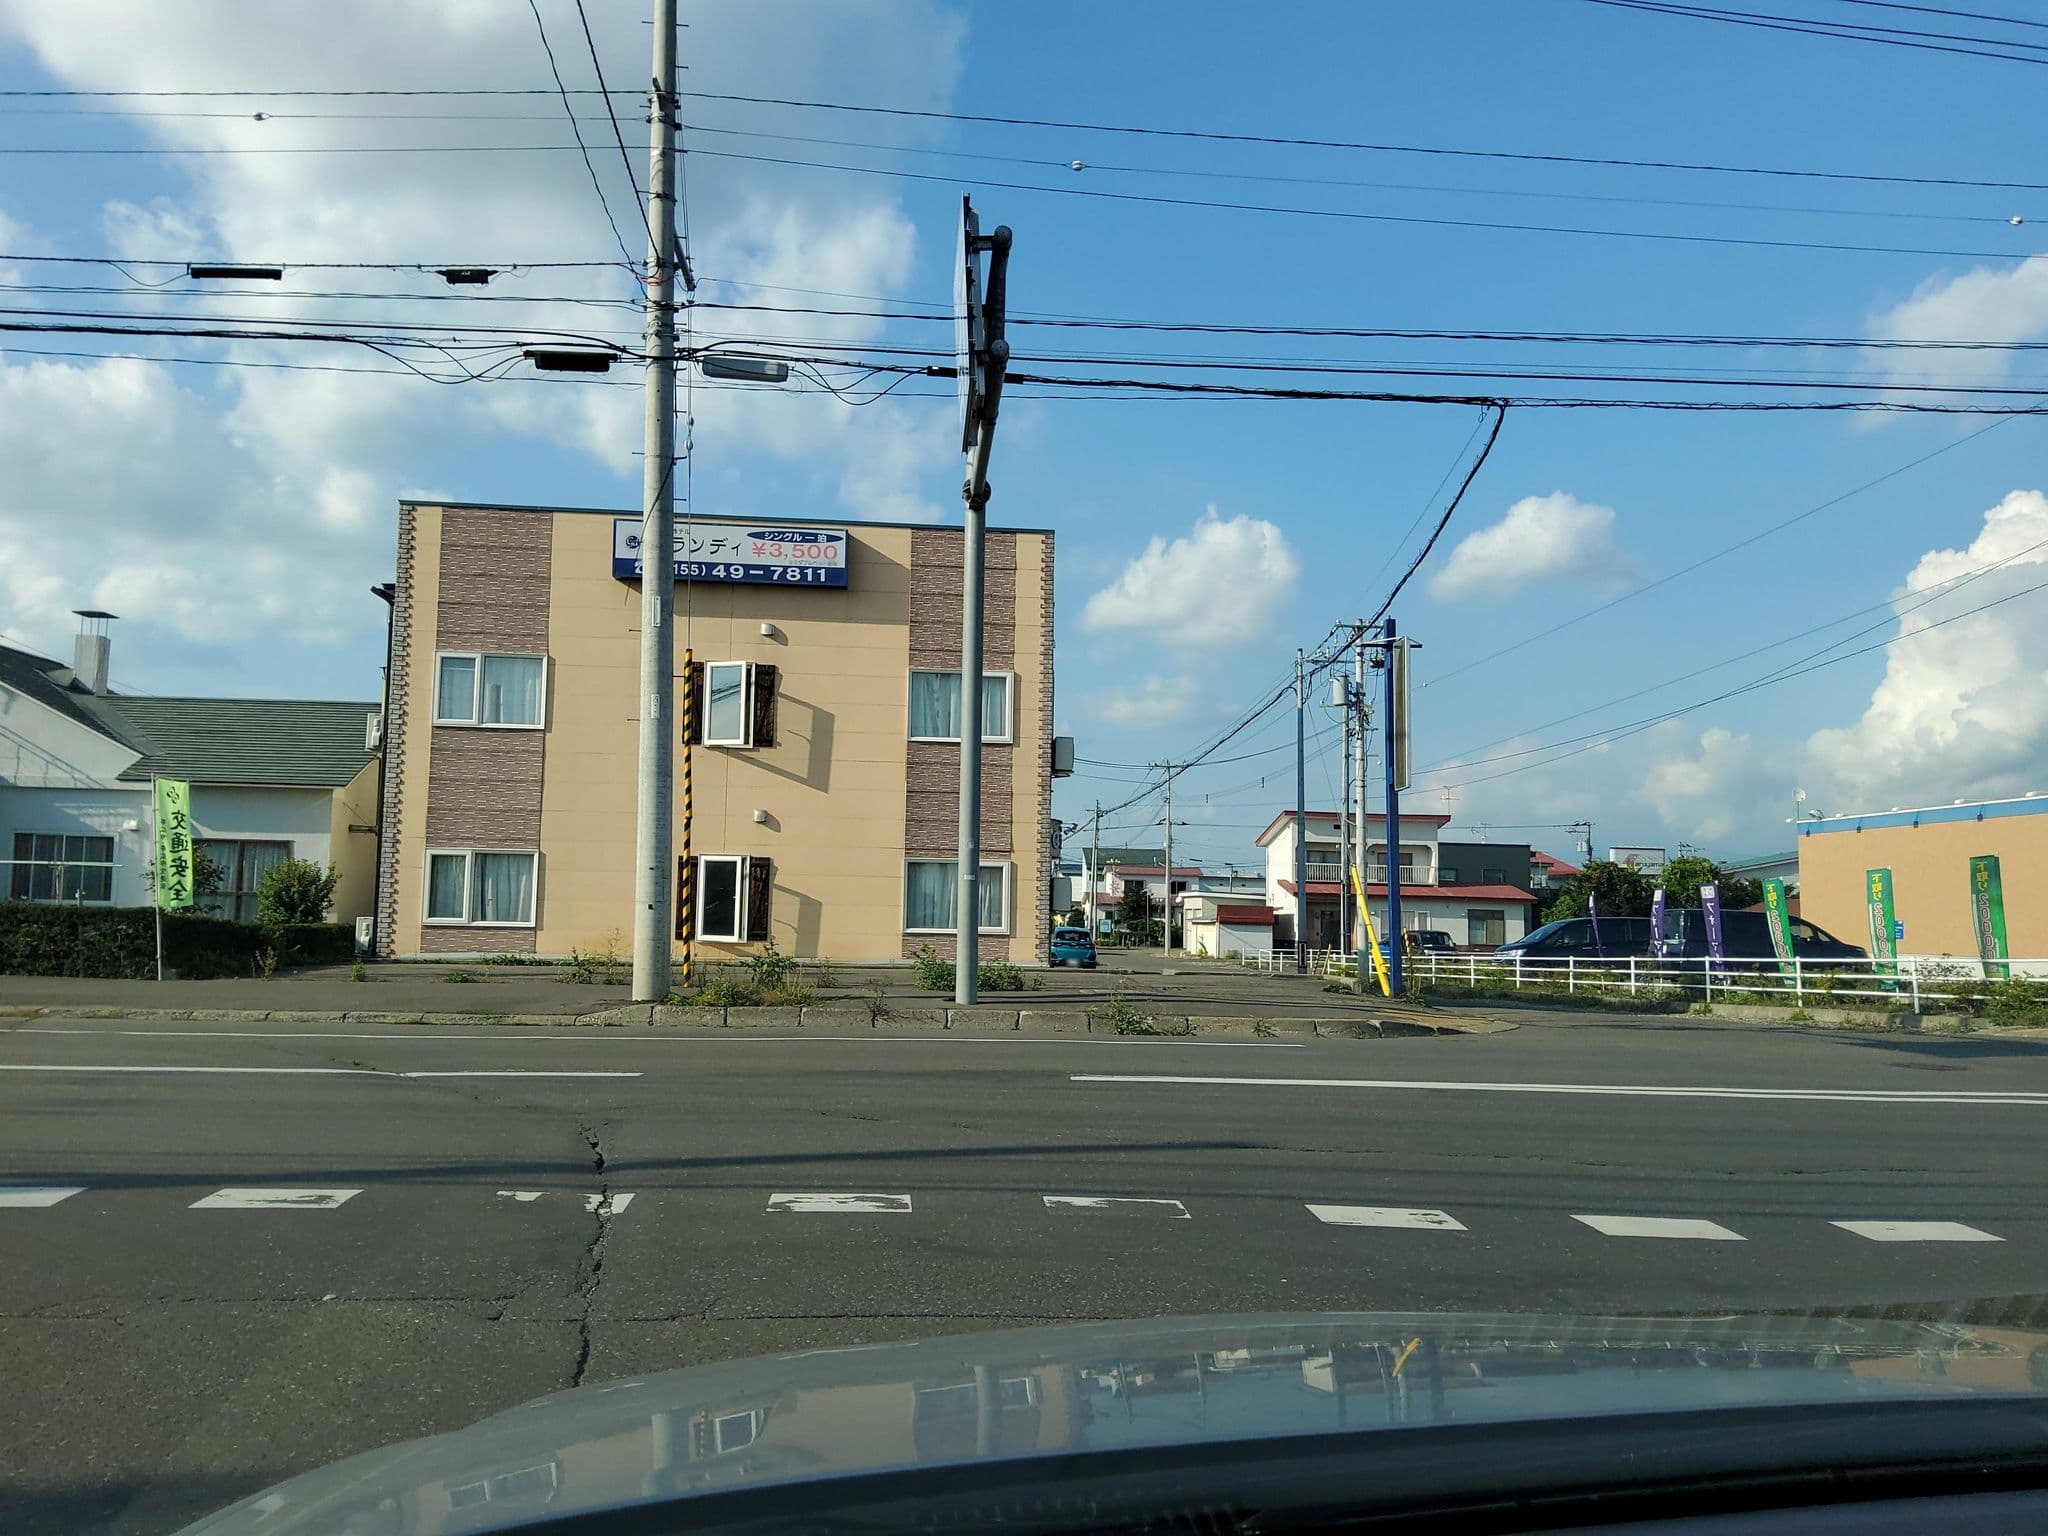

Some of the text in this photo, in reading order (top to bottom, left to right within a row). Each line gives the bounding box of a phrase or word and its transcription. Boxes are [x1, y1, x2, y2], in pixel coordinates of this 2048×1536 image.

[673, 537, 742, 557] ランディ
[752, 542, 838, 560] ¥3,500
